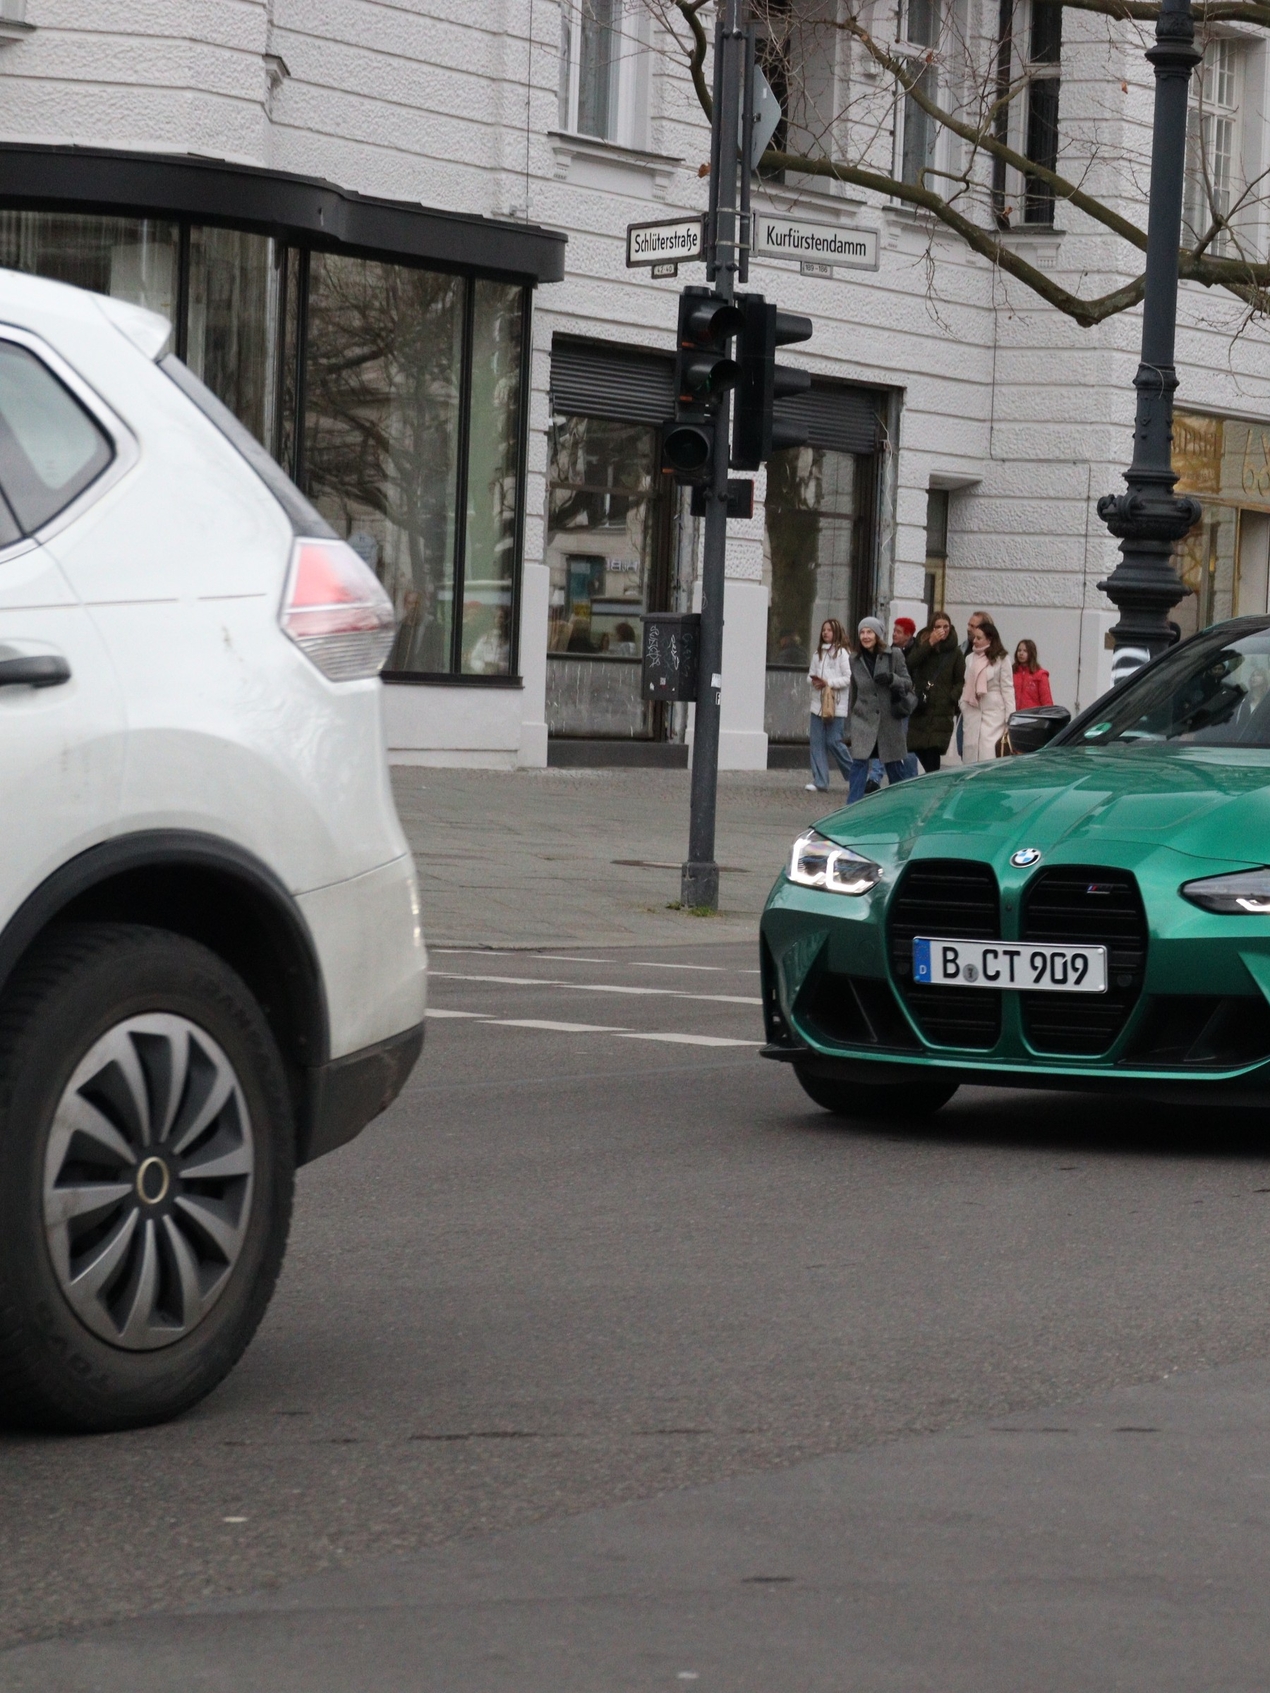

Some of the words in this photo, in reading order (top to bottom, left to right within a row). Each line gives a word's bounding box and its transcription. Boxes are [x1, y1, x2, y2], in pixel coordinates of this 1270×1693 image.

[634, 228, 698, 253] Schlüterstraße
[766, 225, 867, 257] Kurfürstendamm
[919, 964, 927, 975] D
[942, 946, 960, 979] B
[982, 949, 1021, 982] CT
[1029, 951, 1089, 986] 909
